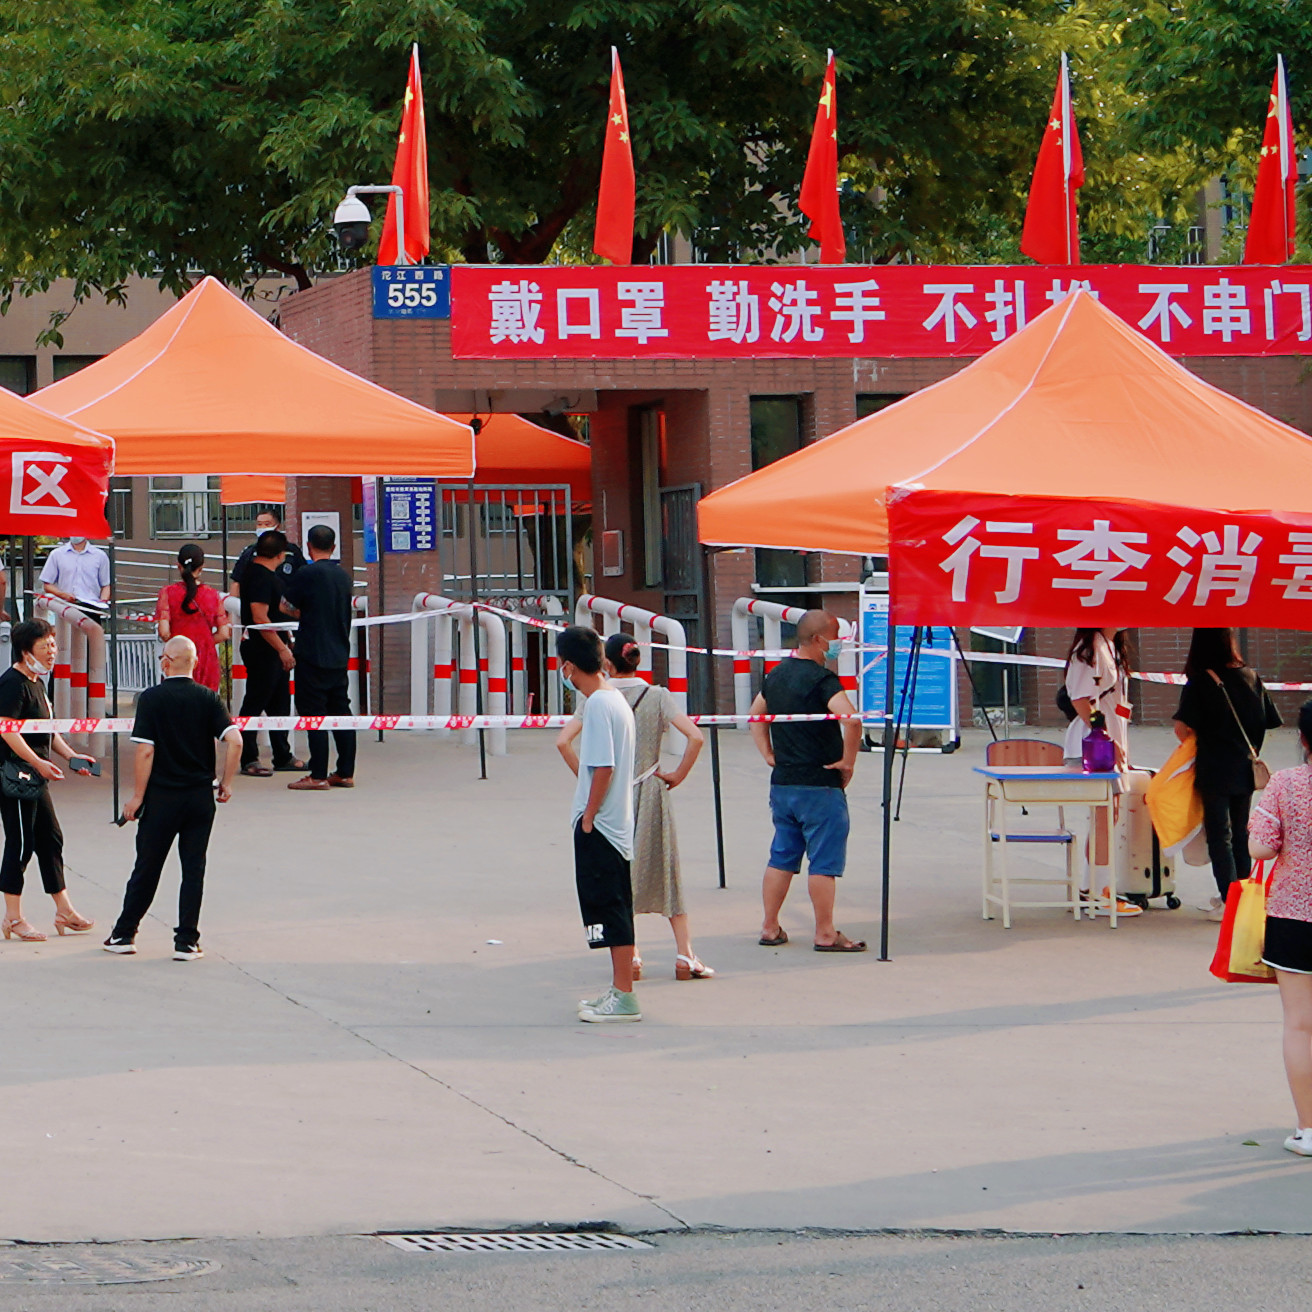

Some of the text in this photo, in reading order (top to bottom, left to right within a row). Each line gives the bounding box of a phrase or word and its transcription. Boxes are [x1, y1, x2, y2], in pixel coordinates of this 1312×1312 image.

[387, 282, 437, 308] 555
[489, 278, 1312, 345] 戴口罩 勤洗手 不扎 不串门
